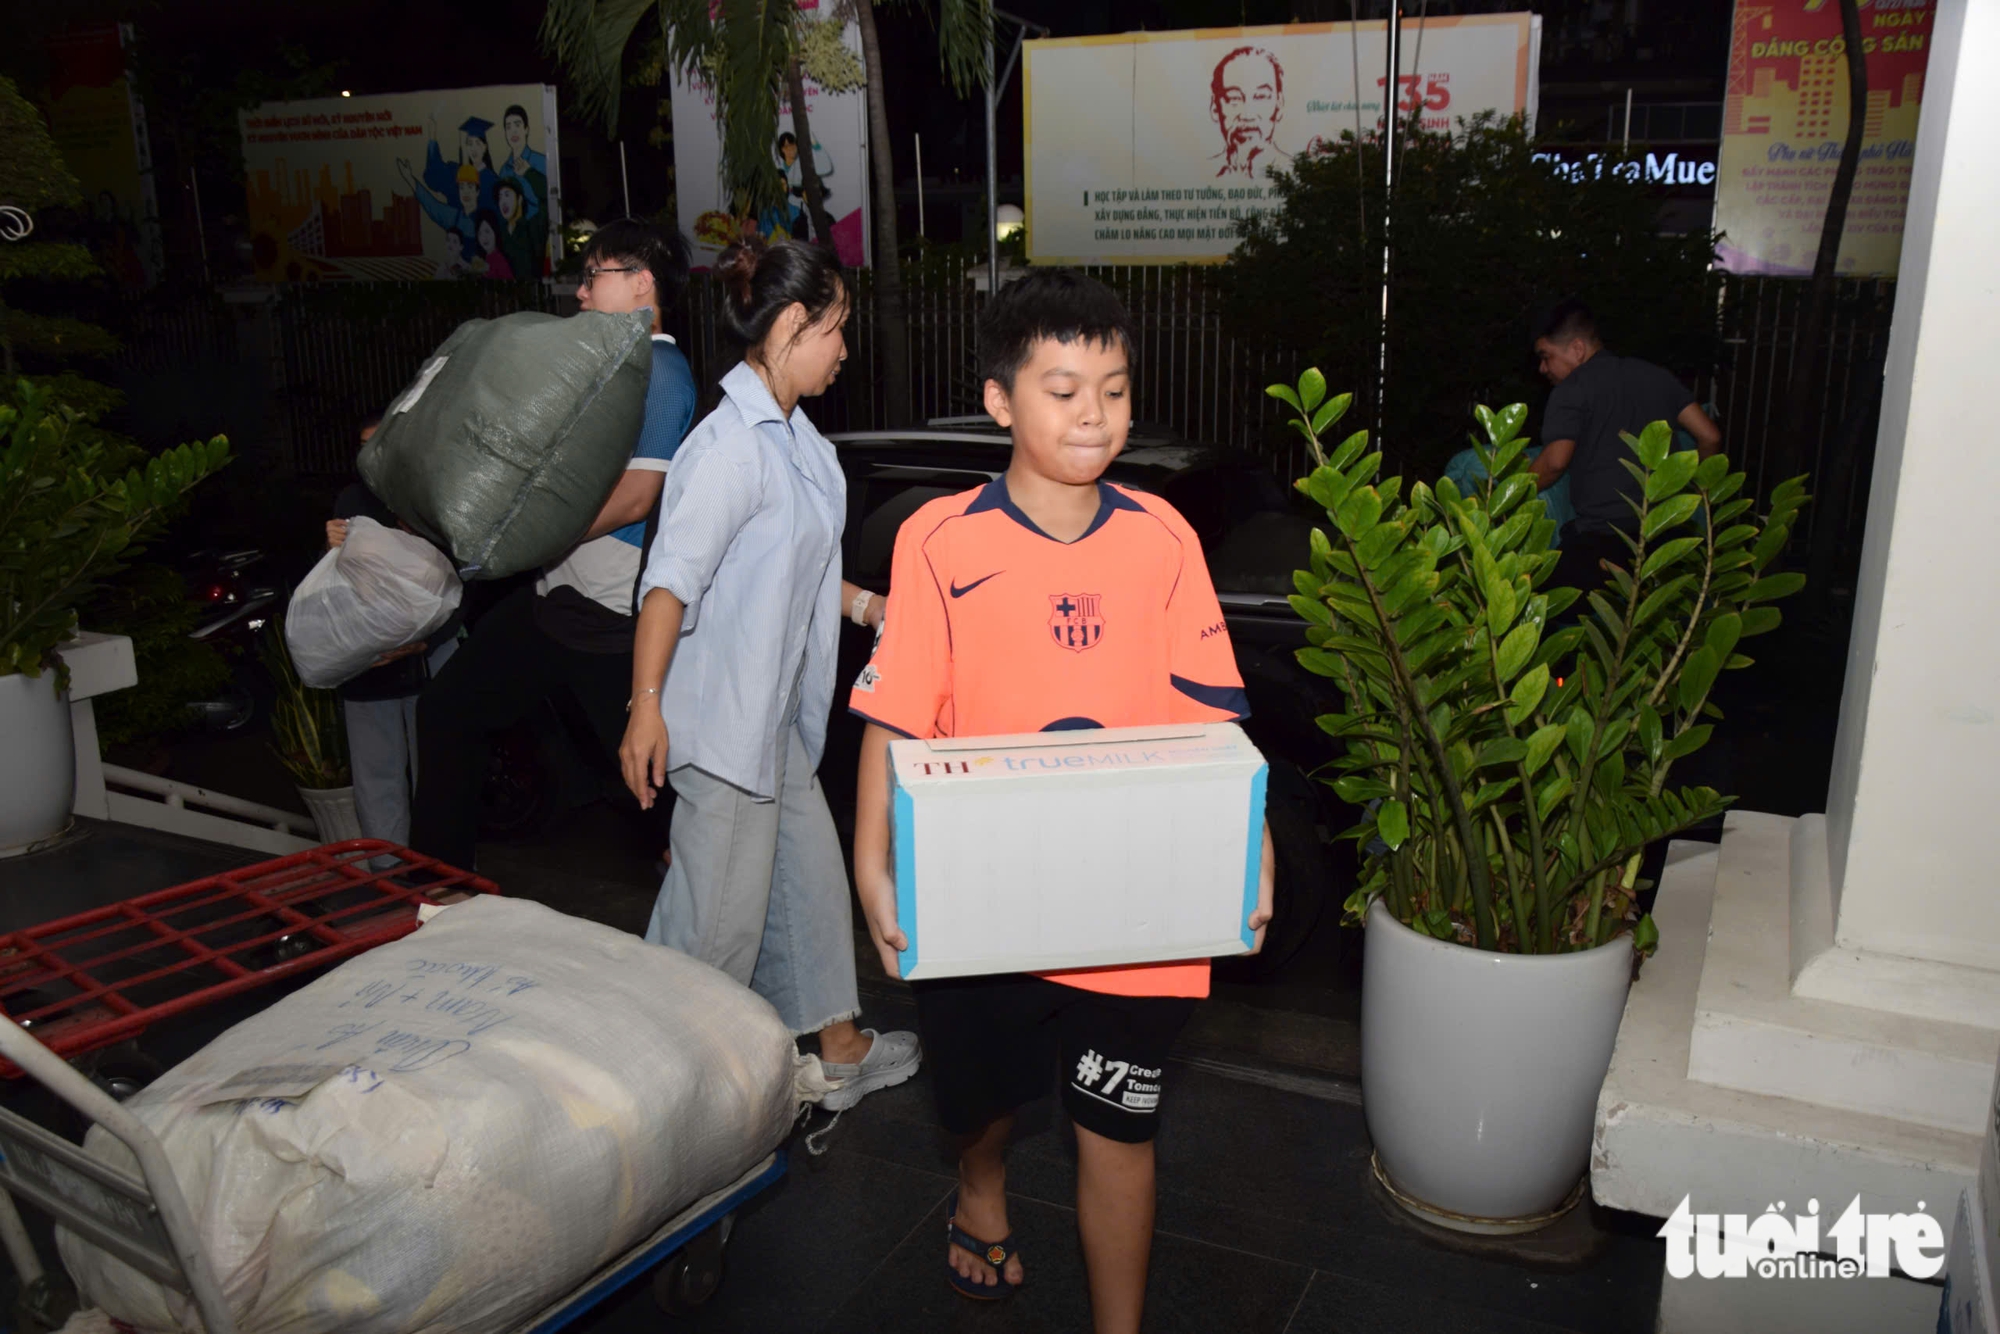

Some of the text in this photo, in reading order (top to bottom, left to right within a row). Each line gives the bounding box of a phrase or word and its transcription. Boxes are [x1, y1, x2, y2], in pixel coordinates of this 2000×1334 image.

[1873, 9, 1925, 27] NGÀY
[1751, 30, 1924, 60] ĐẢNG CỘG SẢN
[386, 125, 402, 138] VIỆT
[404, 126, 422, 136] NAM
[1420, 118, 1449, 130] SINH
[1094, 190, 1110, 204] HỌC
[1112, 188, 1127, 205] TẬP
[1128, 188, 1139, 202] VÀ
[1141, 187, 1159, 201] LÀM
[1161, 189, 1181, 201] THEO
[1183, 188, 1194, 200] TƯ
[1196, 185, 1226, 202] TƯỞNG,
[1228, 188, 1245, 202] ĐẠO
[1247, 185, 1266, 200] ĐỨC,
[1094, 208, 1111, 221] XÂY
[1113, 209, 1135, 223] DỰNG
[1137, 206, 1162, 222] ĐẢNG,
[1165, 209, 1185, 222] THỰC
[1187, 206, 1206, 222] HIỆN
[1209, 203, 1227, 219] TIẾN
[1094, 226, 1119, 240] CHĂM
[1121, 229, 1131, 240] LO
[1133, 226, 1156, 240] NÂNG
[1159, 228, 1175, 240] CAO
[1178, 228, 1194, 241] MỌI
[1197, 225, 1215, 241] MẶT
[913, 761, 970, 775] TH
[425, 990, 519, 1036] Nam
[1076, 1048, 1129, 1095] #7
